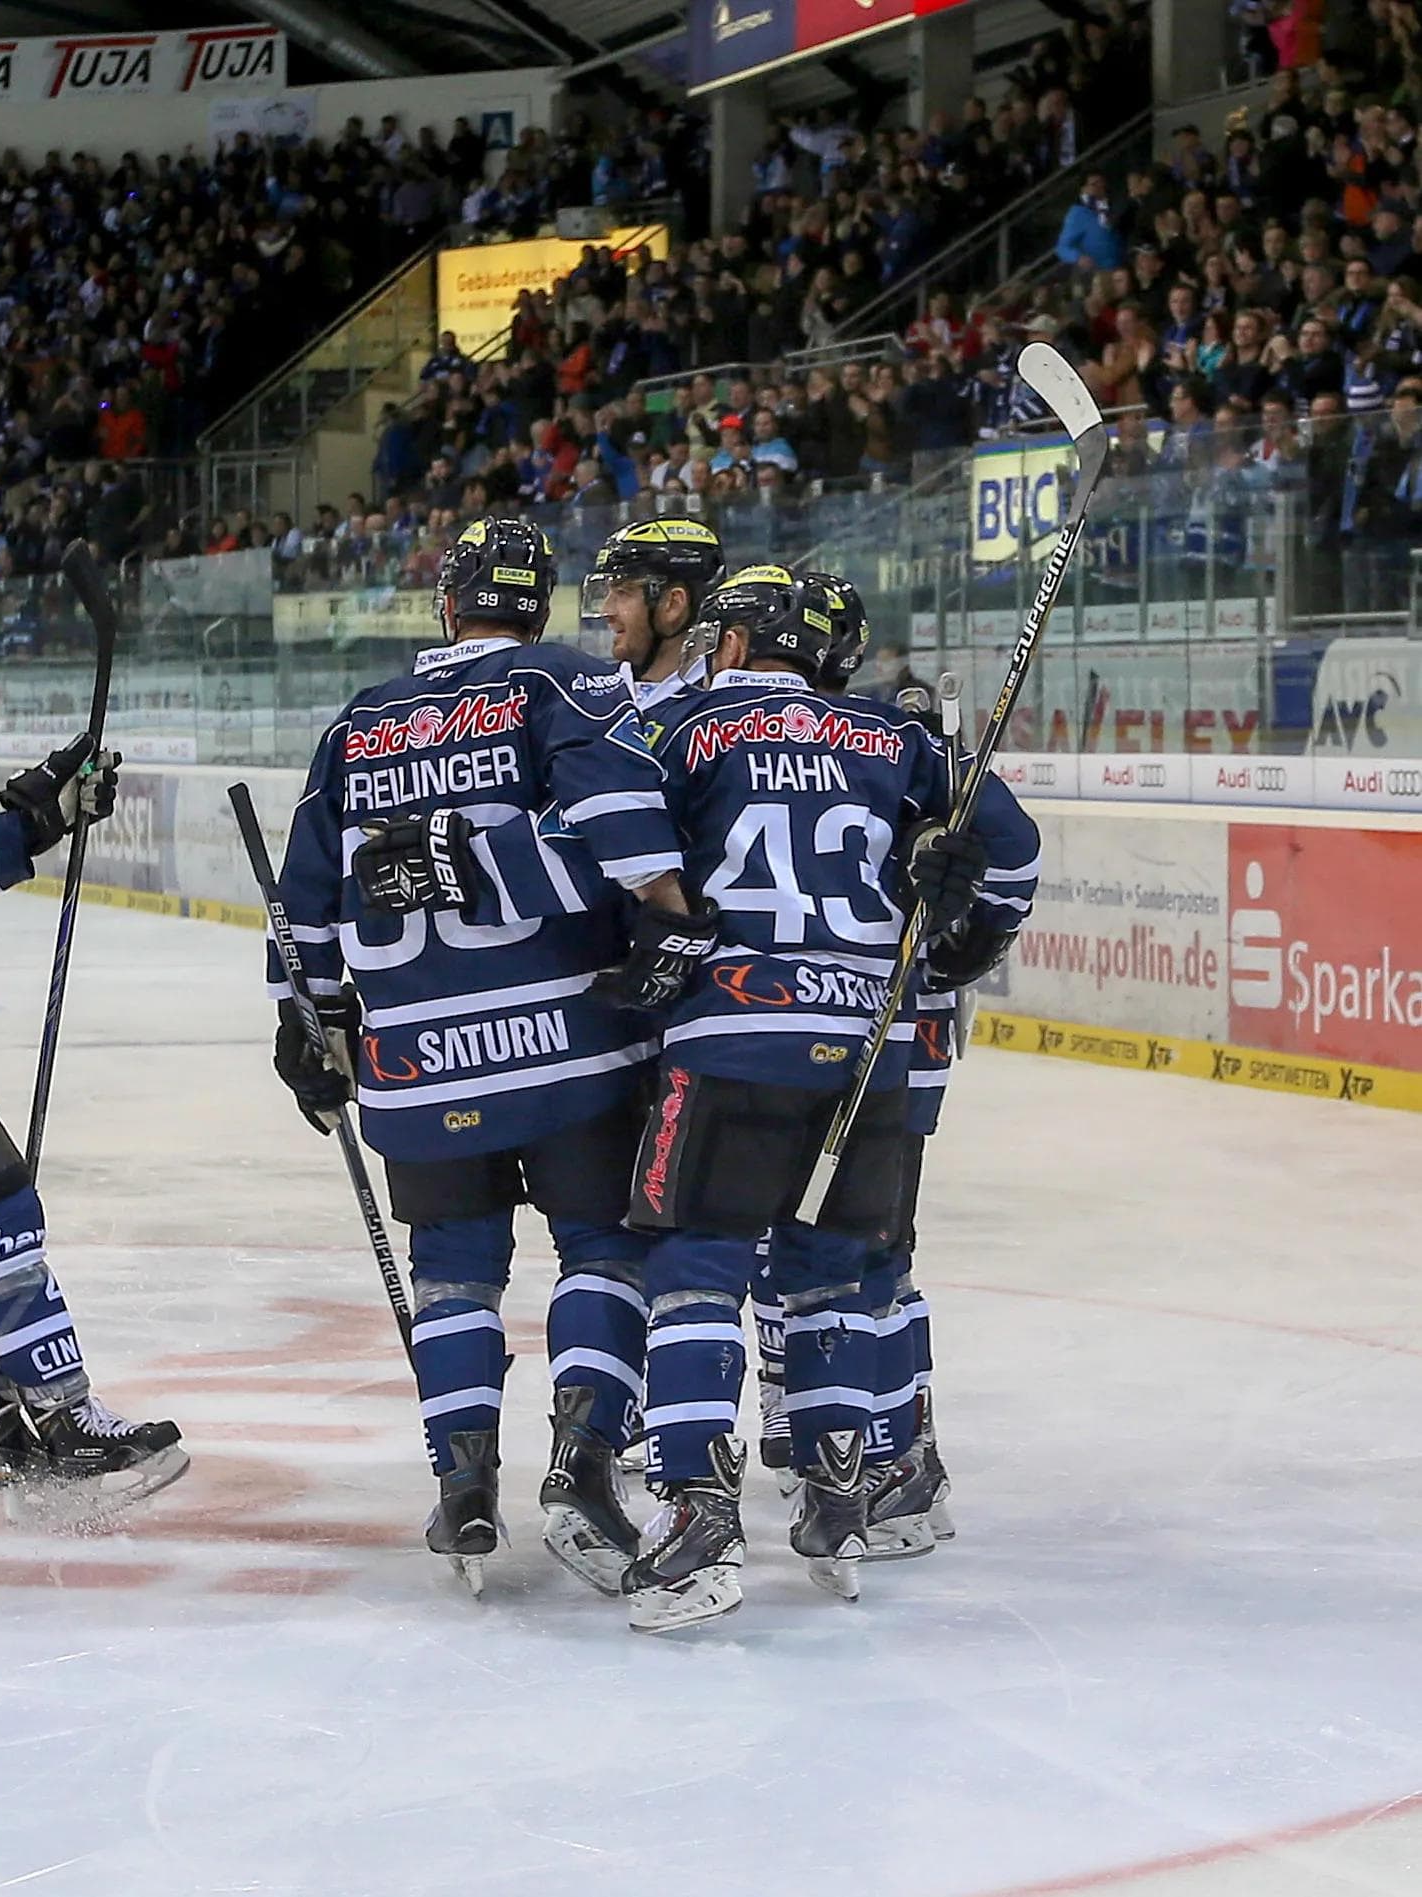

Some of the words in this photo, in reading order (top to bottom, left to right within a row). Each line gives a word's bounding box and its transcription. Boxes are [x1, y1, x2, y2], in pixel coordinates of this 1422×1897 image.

[49, 36, 158, 98] TUJA
[182, 27, 278, 92] TUJA
[478, 592, 499, 606] 39
[517, 598, 538, 612] 39
[1013, 525, 1074, 673] SUPREME
[777, 632, 798, 649] 43
[840, 656, 856, 669] 42
[687, 707, 785, 775] Media
[813, 711, 904, 764] Markt
[748, 752, 849, 794] HAHN
[1103, 766, 1134, 785] Audi
[1217, 767, 1251, 788] Audi
[1344, 770, 1383, 792] Audi
[701, 803, 905, 946] 43
[270, 901, 303, 972] BAUER
[1019, 923, 1219, 991] www.pollin.de
[1288, 940, 1422, 1033] Sparka
[417, 1009, 570, 1074] SATURN
